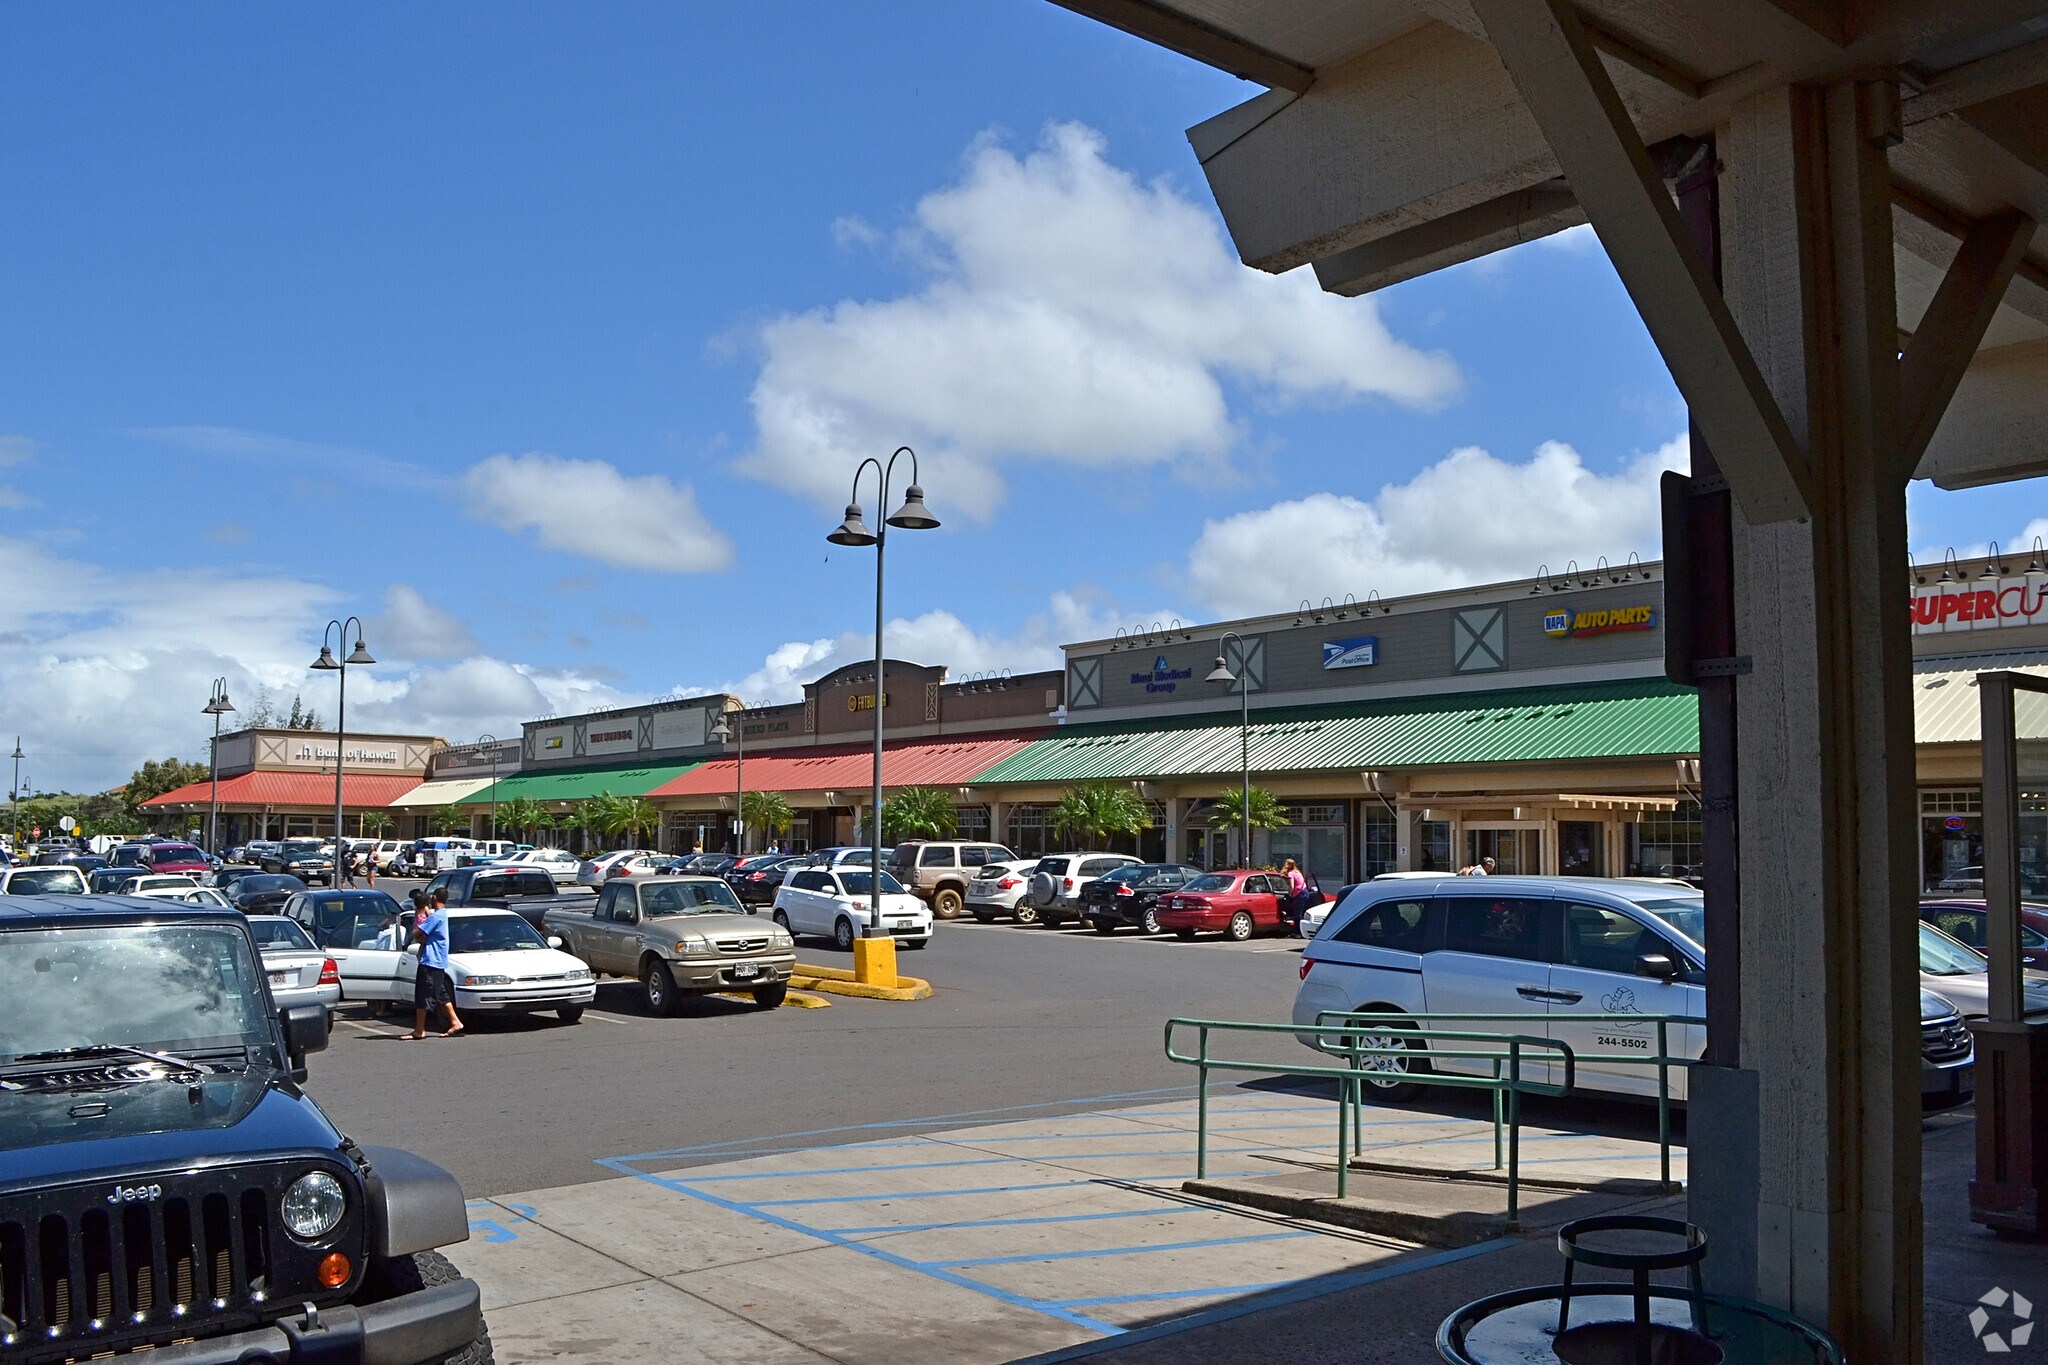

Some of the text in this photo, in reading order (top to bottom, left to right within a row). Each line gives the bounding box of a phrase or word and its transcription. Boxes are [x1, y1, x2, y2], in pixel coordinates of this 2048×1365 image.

[1545, 615, 1566, 630] NAPA
[1573, 605, 1652, 629] AUTO PARTS
[1131, 668, 1192, 684] Maui Medical
[1146, 683, 1176, 693] Group
[317, 747, 397, 760] Ban of Hawaii
[1597, 1036, 1648, 1049] 244-5502
[107, 1183, 162, 1204] Jeep
